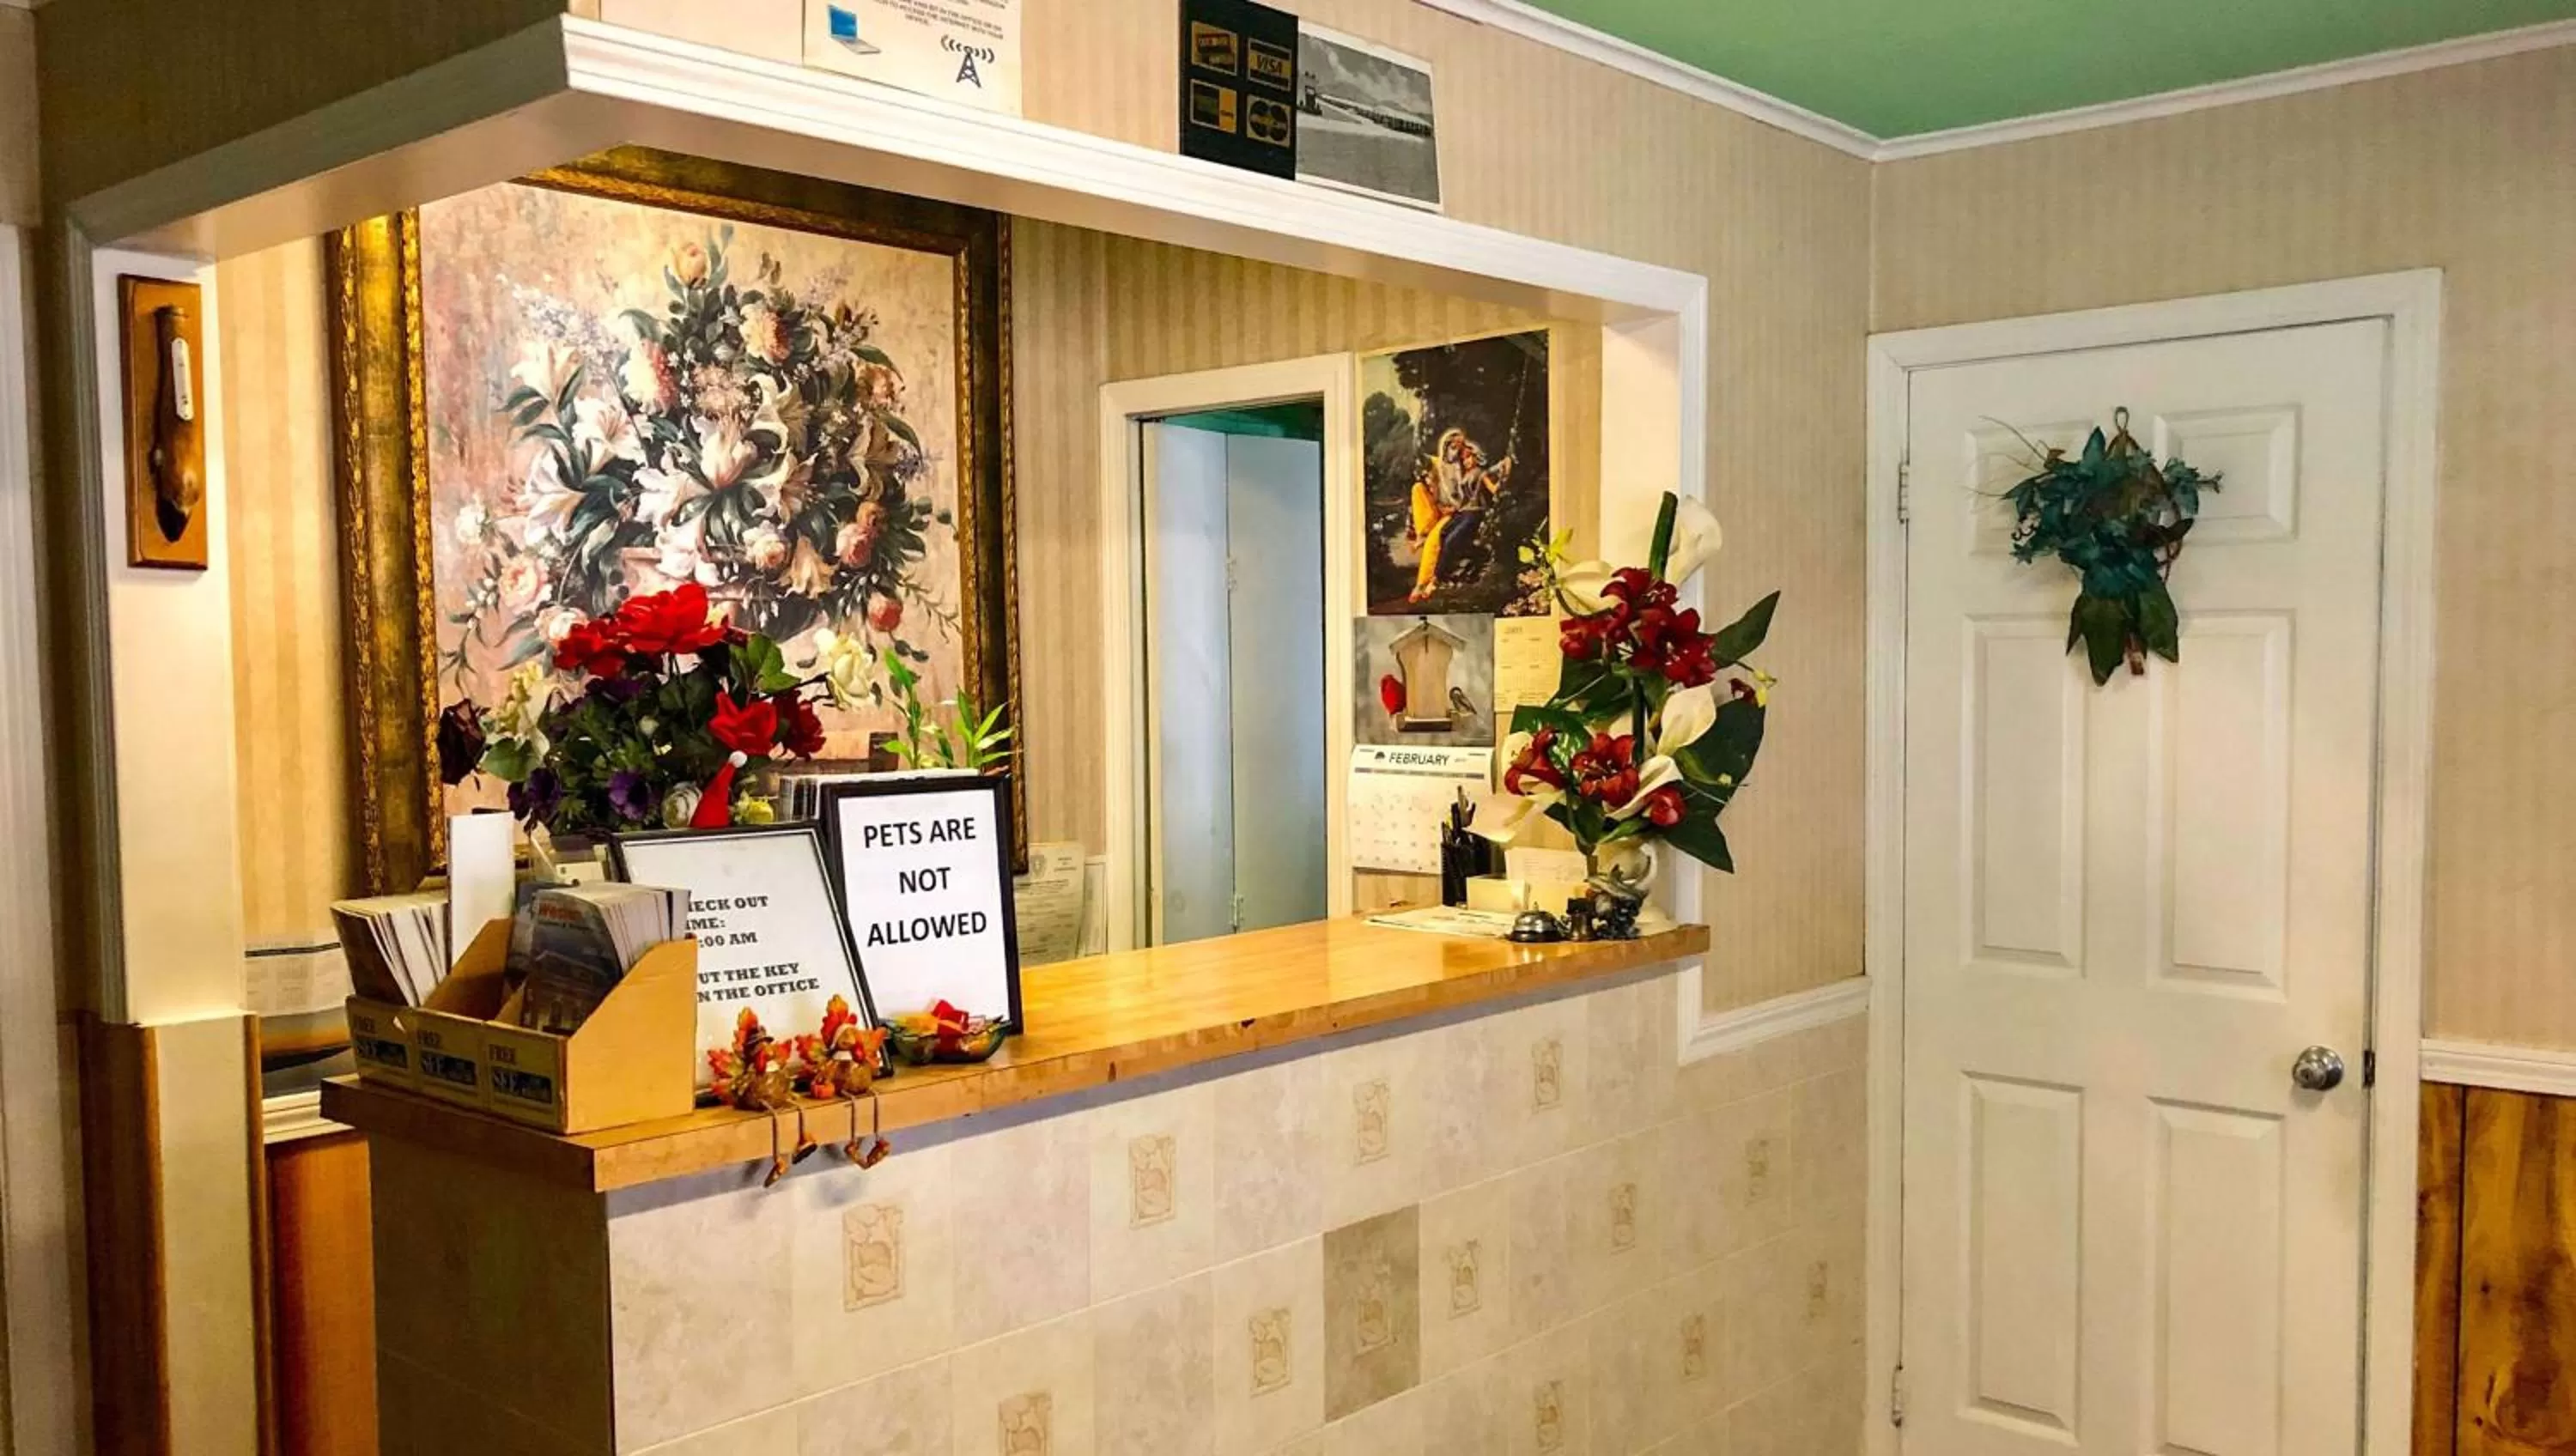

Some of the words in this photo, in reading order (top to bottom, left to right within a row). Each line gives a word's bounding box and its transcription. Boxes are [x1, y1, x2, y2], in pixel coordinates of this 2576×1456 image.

[1257, 54, 1283, 76] VISA
[1388, 751, 1450, 767] FEBRUARY
[863, 822, 923, 849] PETS
[929, 816, 977, 844] ARE
[899, 866, 951, 895] NOT
[688, 898, 731, 912] ECK
[734, 895, 769, 909] OUT
[684, 917, 726, 931] IME:
[866, 910, 987, 948] ALLOWED
[698, 935, 726, 948] :00
[729, 931, 758, 946] AM
[698, 971, 720, 985] UT
[724, 967, 761, 981] THE
[763, 962, 799, 978] KEY
[697, 990, 711, 1004] N
[713, 986, 751, 1002] THE
[754, 977, 821, 997] OFFICE
